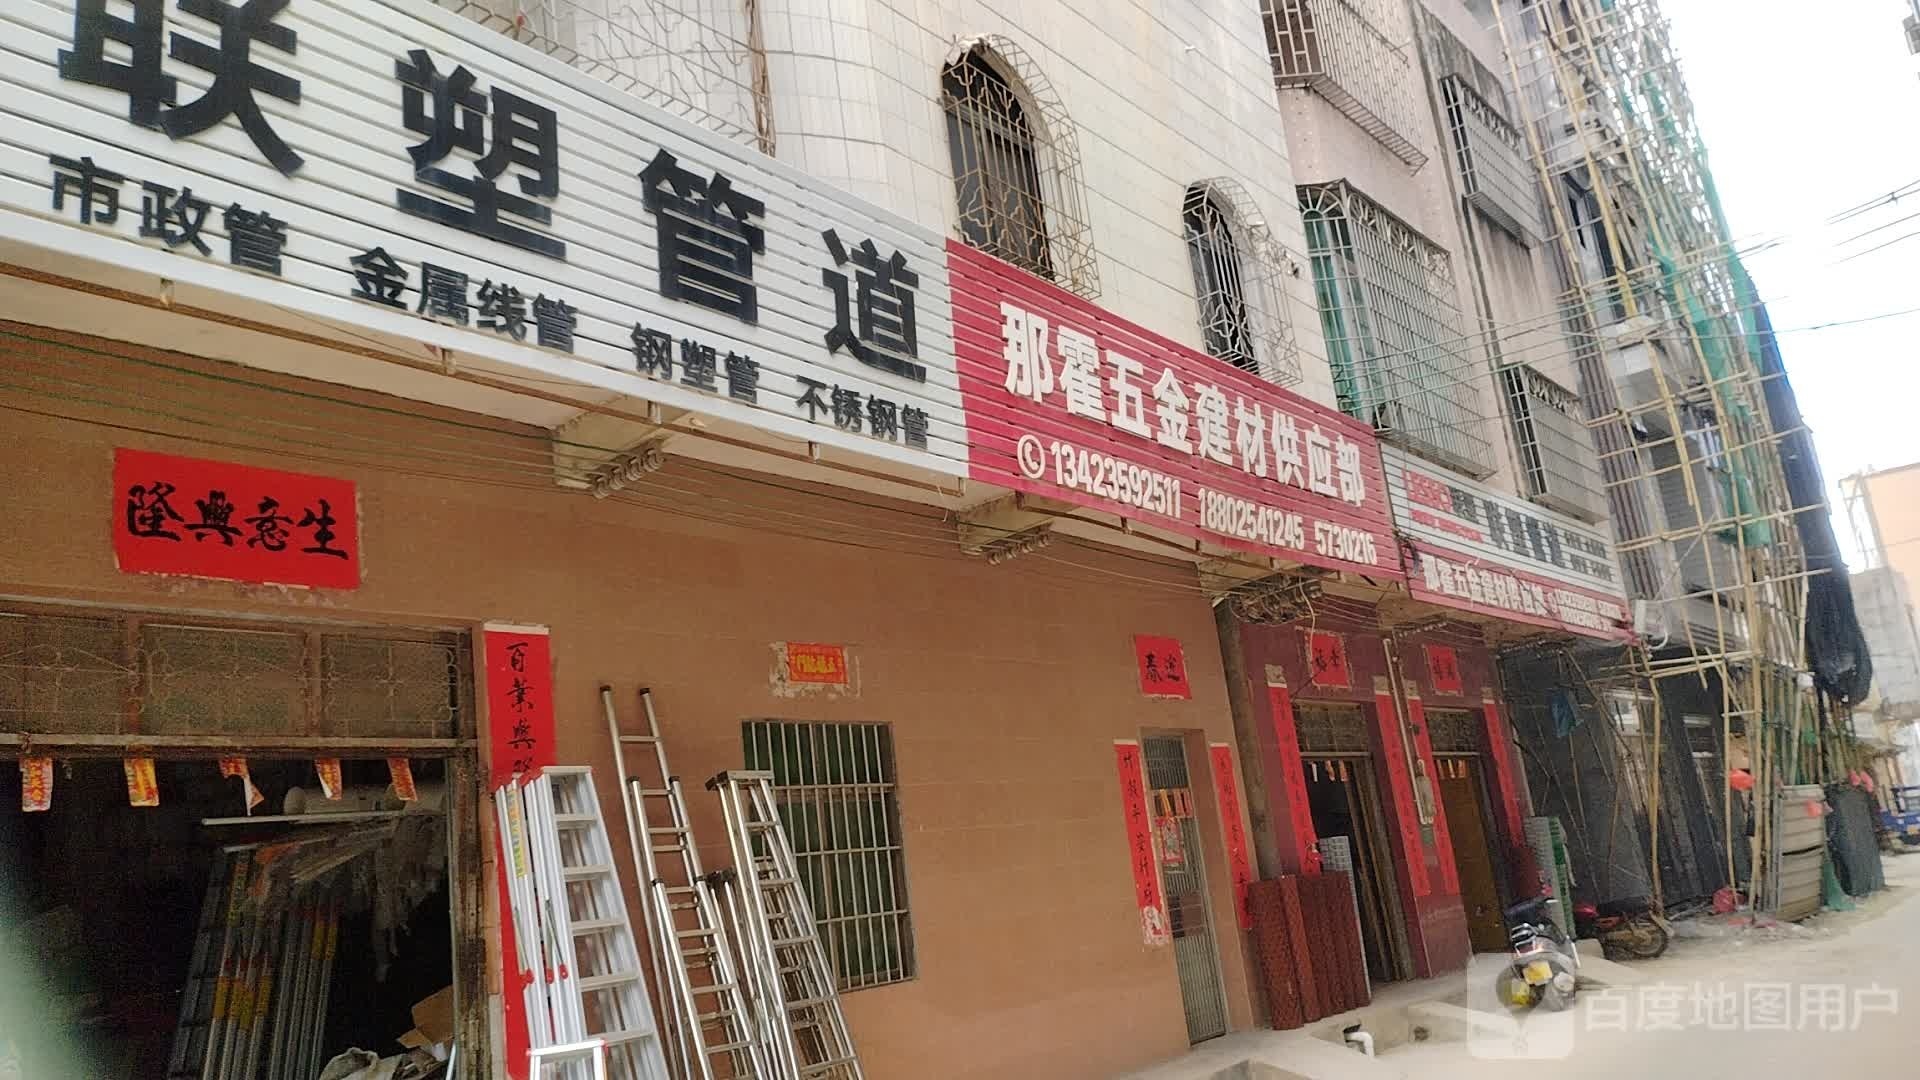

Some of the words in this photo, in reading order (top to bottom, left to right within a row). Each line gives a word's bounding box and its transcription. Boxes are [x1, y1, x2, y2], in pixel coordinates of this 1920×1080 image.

[50, 154, 288, 277] 市政管
[349, 246, 577, 354] 金属线管
[631, 322, 759, 404] 钢塑管
[796, 374, 929, 451] 不锈钢管
[1000, 301, 1366, 507] 那霍五金建材供应部
[1050, 441, 1181, 519] 13423592511
[1198, 488, 1304, 550] 18802541245
[1314, 520, 1377, 565] 5730216
